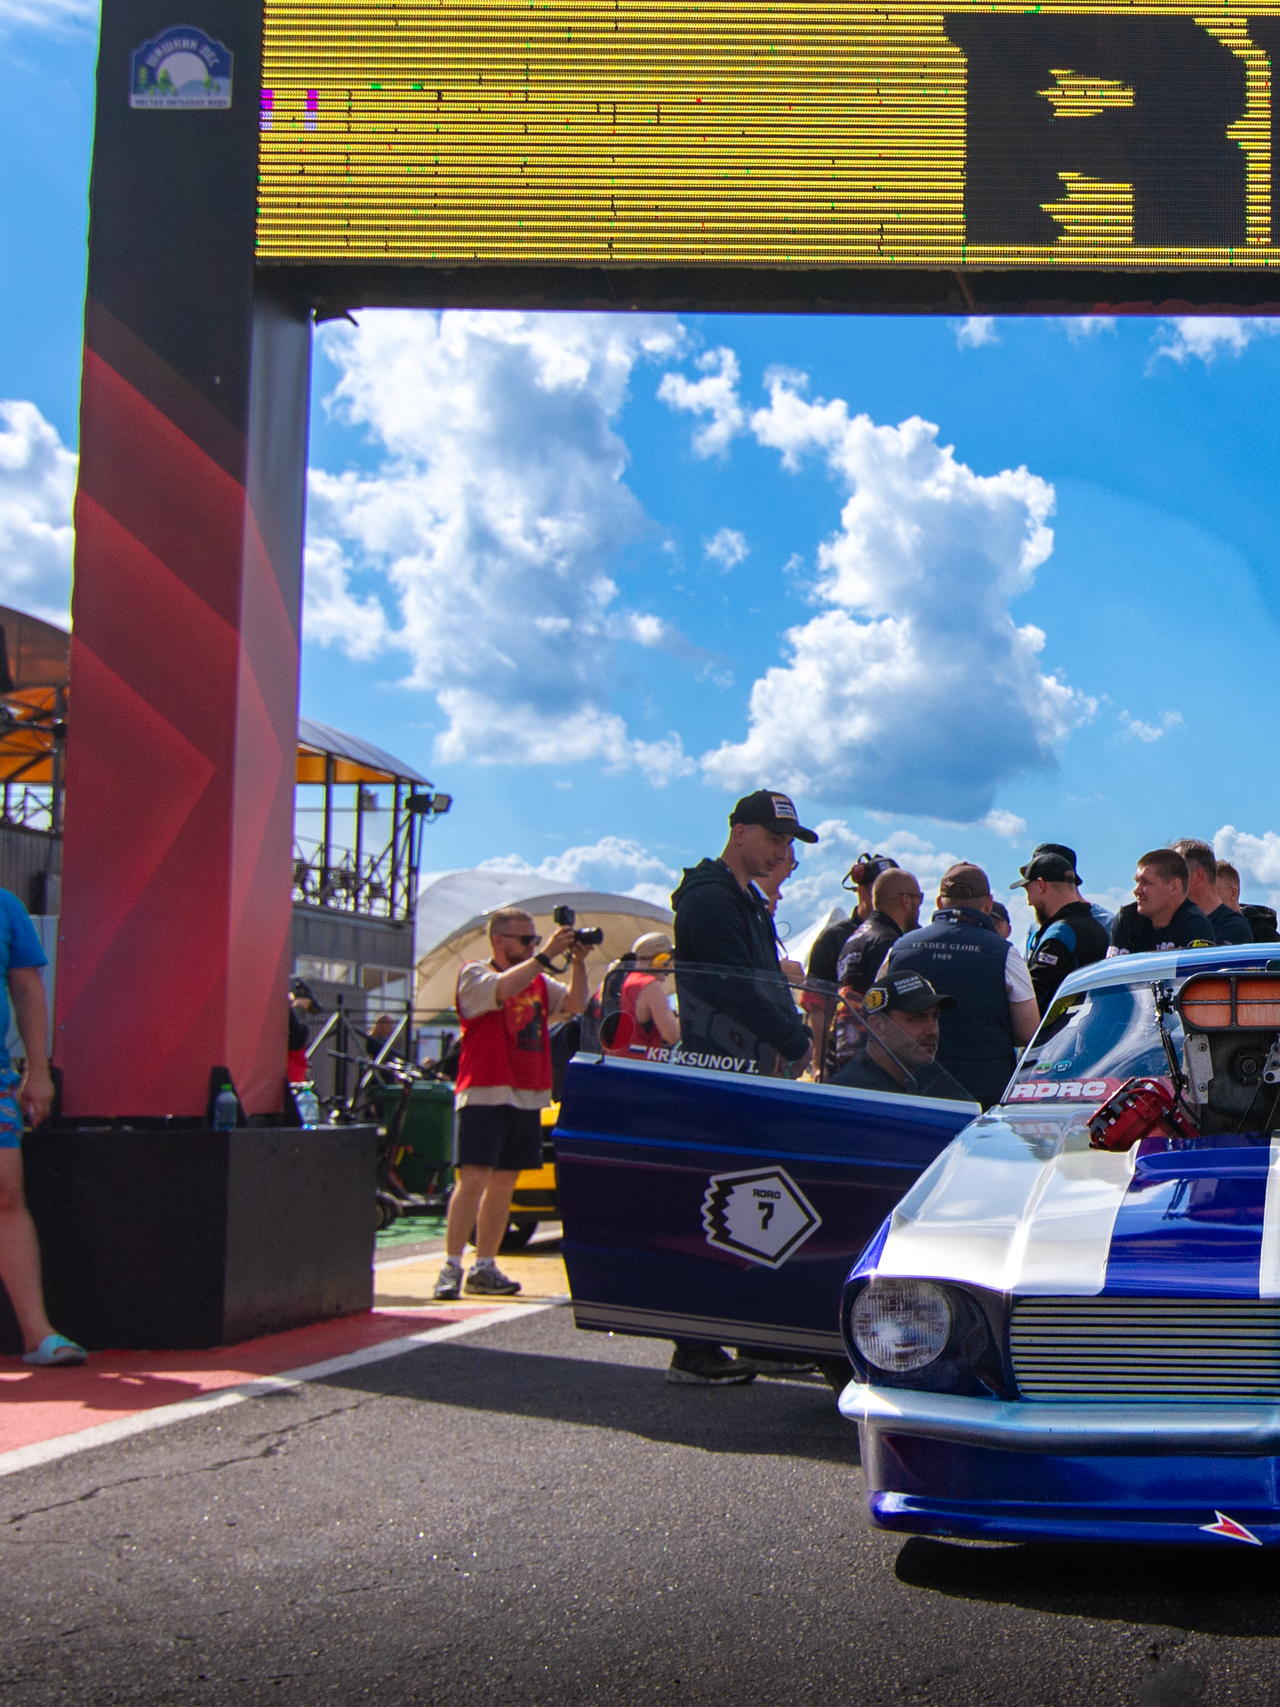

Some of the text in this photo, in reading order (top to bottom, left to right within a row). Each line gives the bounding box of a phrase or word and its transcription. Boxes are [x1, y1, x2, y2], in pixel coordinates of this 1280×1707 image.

[949, 943, 982, 953] GLOBE
[1066, 1003, 1093, 1027] 7
[646, 1047, 759, 1074] KRIKSUNOV I.
[1010, 1081, 1107, 1098] RDRC
[753, 1189, 781, 1199] RDRC
[758, 1201, 774, 1230] 7
